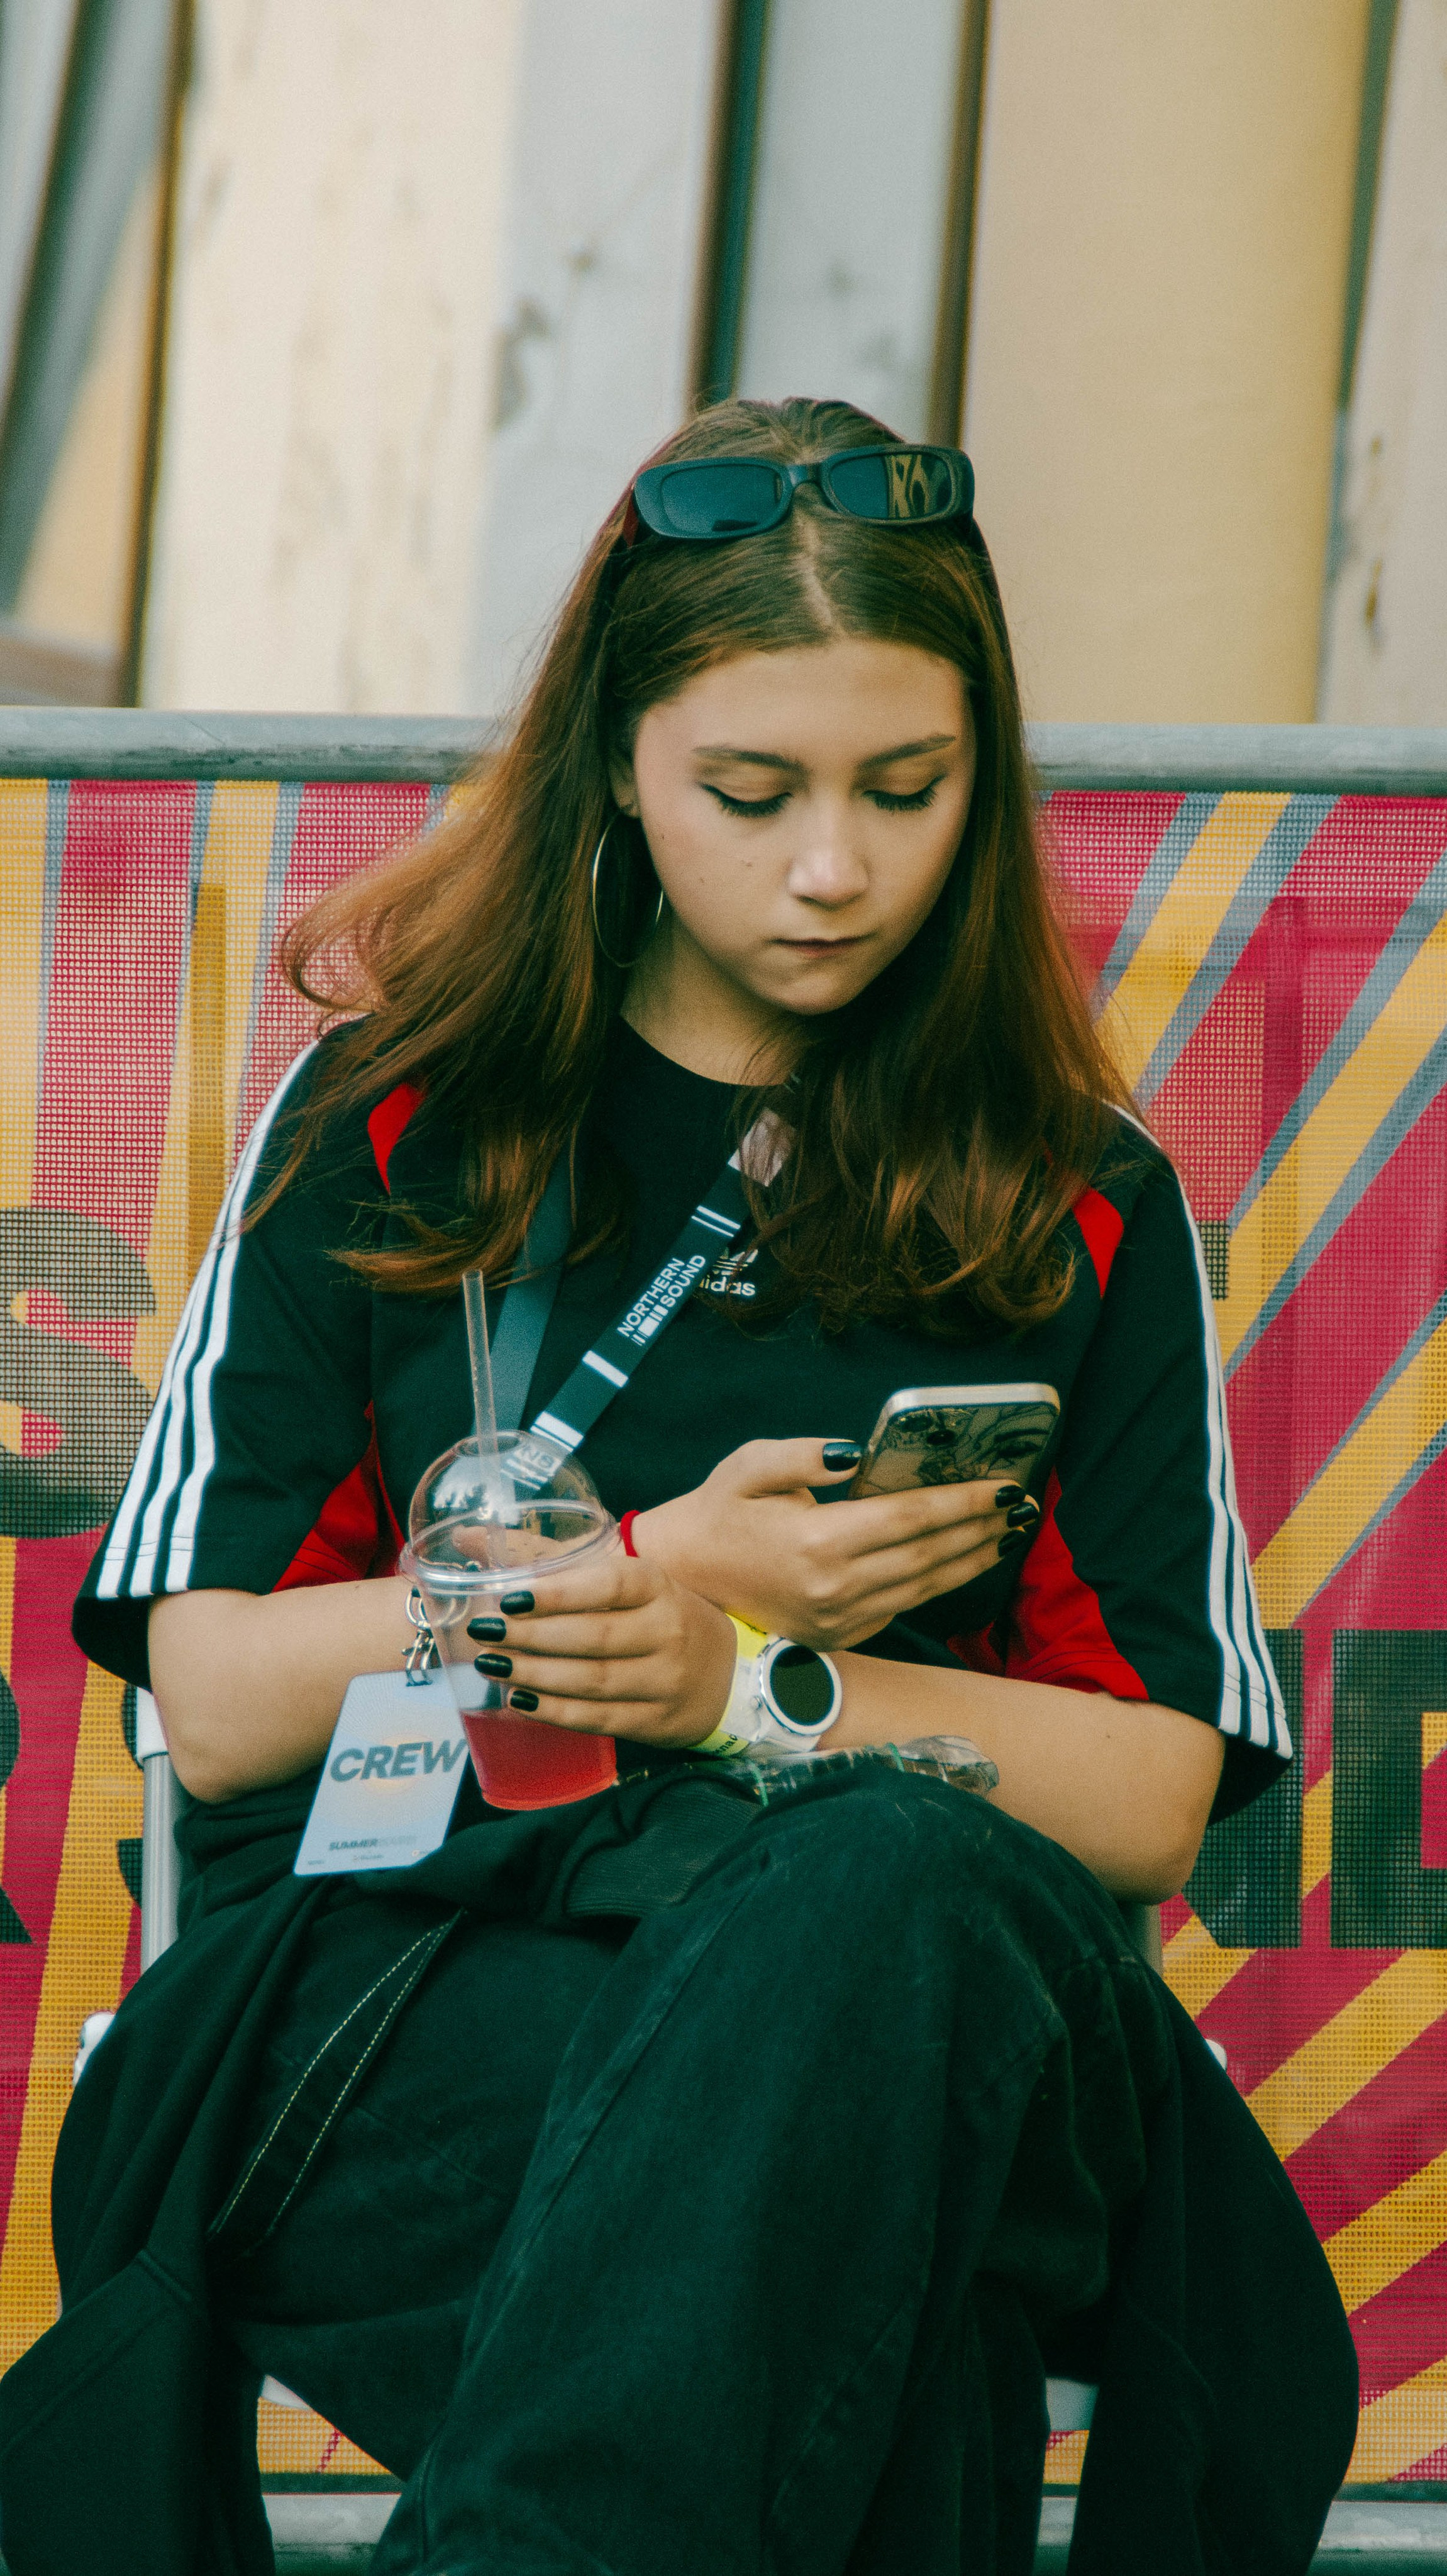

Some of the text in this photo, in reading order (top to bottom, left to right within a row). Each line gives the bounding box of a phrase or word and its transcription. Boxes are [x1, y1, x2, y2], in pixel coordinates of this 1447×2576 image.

[617, 1258, 685, 1336] NORTHERN
[661, 1255, 706, 1307] SOUND
[699, 1275, 755, 1296] idas
[331, 1739, 467, 1782] CREW
